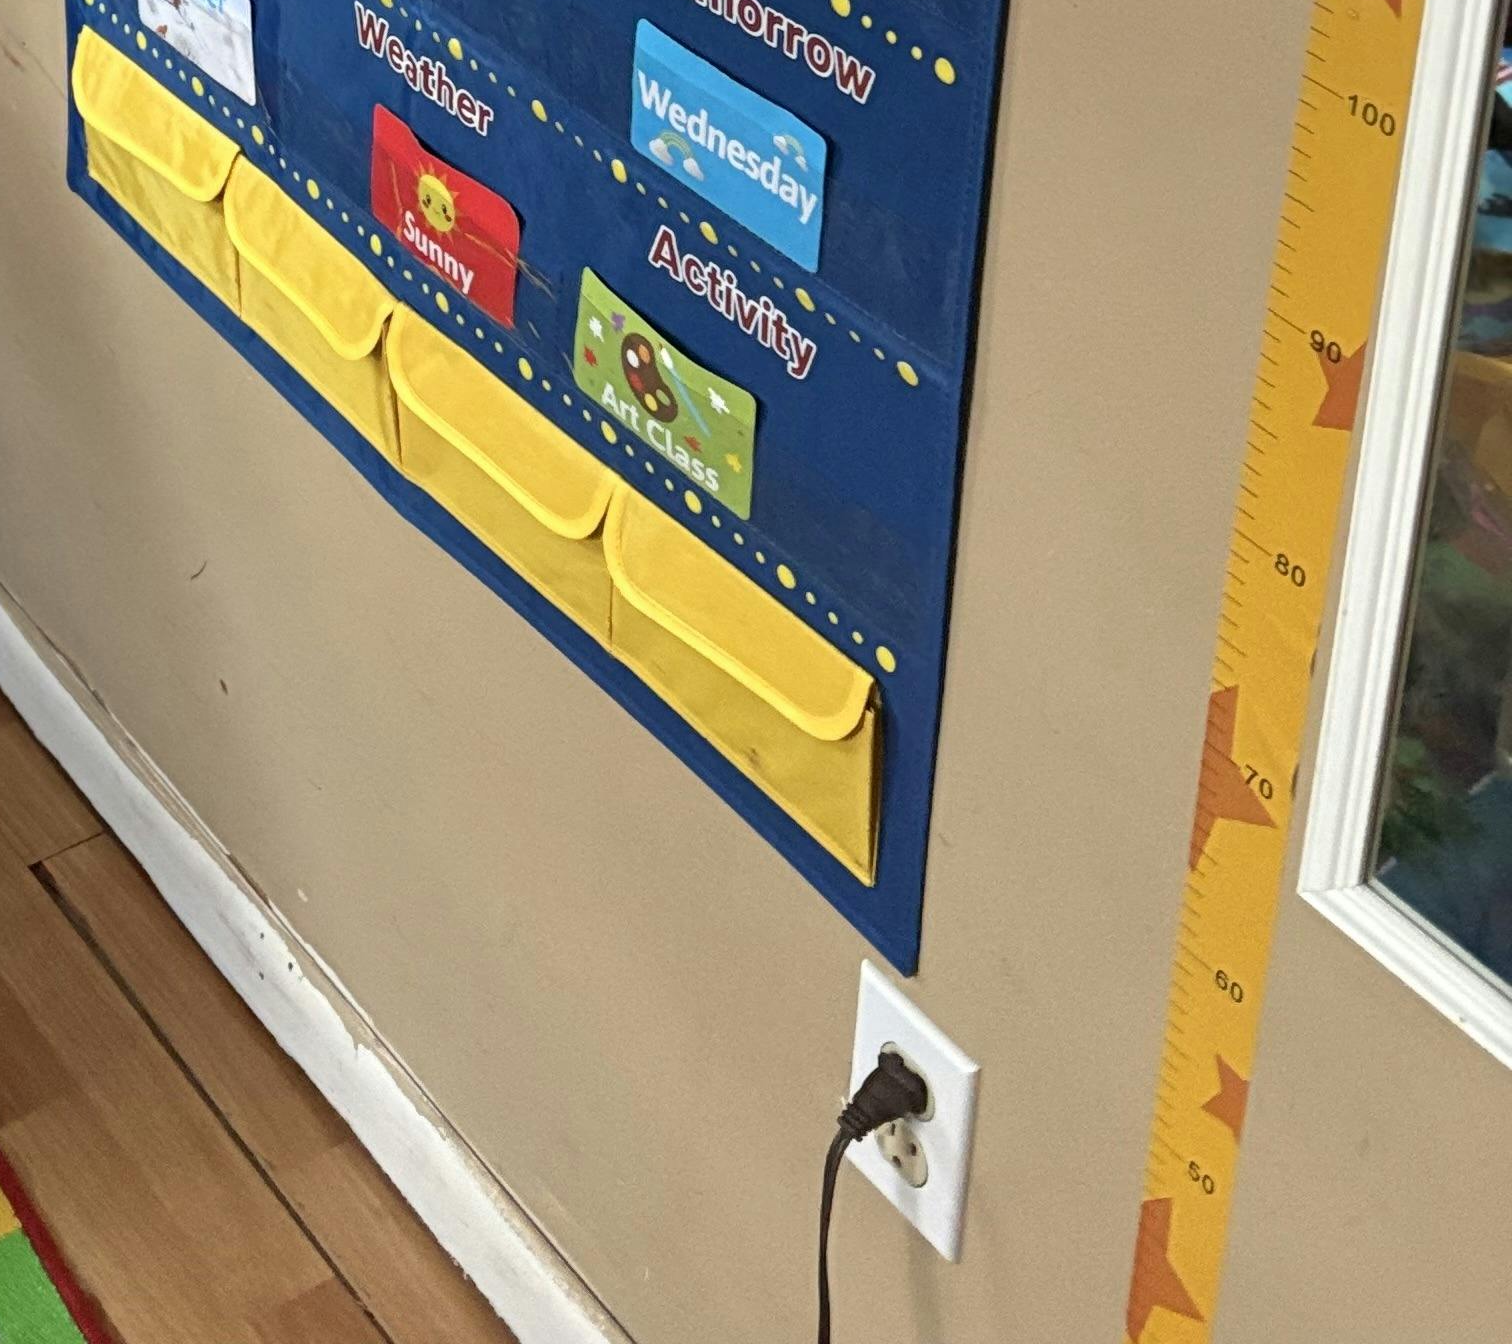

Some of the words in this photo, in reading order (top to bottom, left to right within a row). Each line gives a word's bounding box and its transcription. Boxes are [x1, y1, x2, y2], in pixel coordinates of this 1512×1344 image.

[353, 0, 493, 137] Weather
[1346, 94, 1396, 137] 100
[636, 71, 818, 225] Wednesday
[402, 213, 474, 296] Sunny
[648, 225, 817, 381] Activity
[1310, 329, 1342, 364] 90
[601, 383, 642, 434] Art
[645, 419, 719, 494] Class
[1274, 554, 1306, 587] 80
[1245, 764, 1273, 800] 70
[1213, 968, 1245, 1005] 60
[1186, 1158, 1217, 1197] 50
